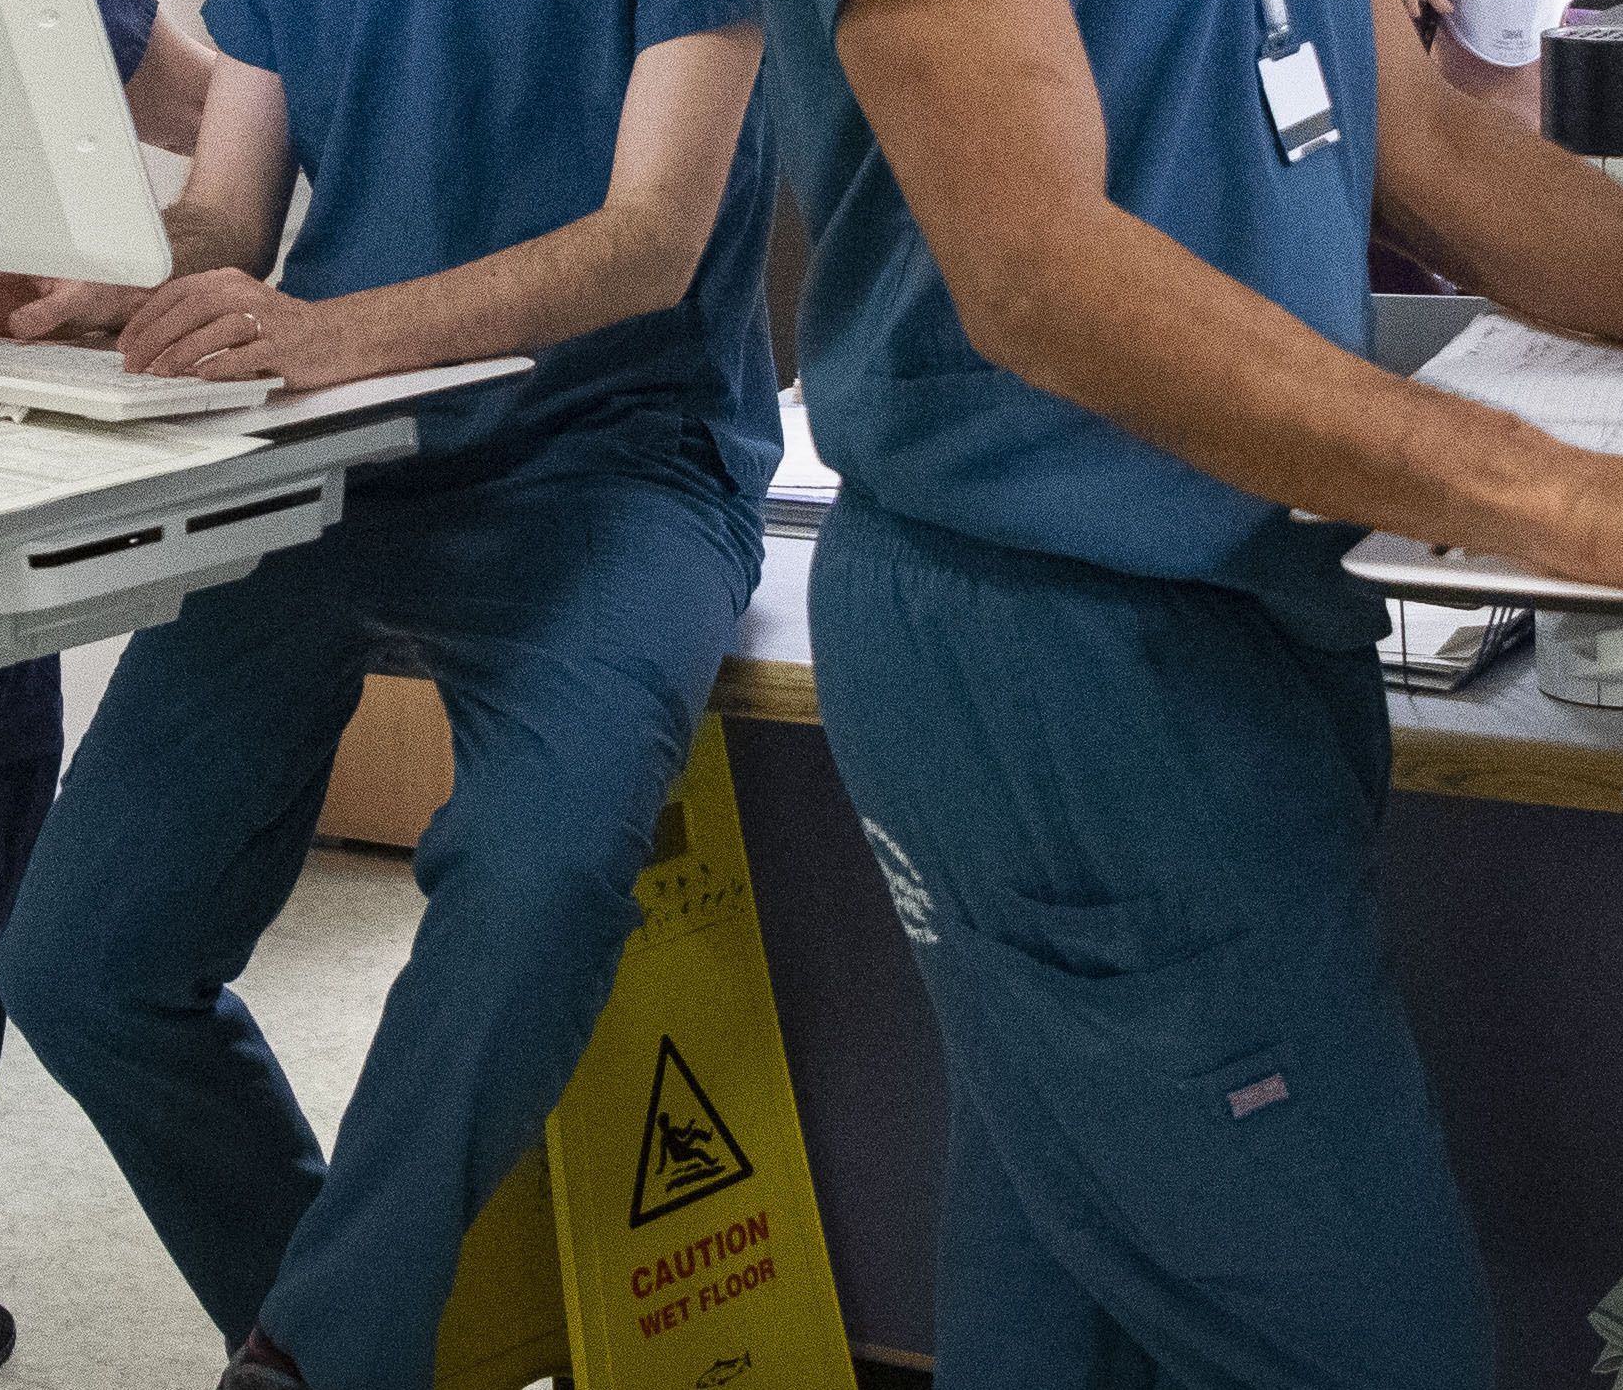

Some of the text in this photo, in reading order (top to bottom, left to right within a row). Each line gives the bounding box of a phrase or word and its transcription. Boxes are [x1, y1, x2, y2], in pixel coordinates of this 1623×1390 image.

[631, 1210, 769, 1299] CAUTION
[639, 1257, 776, 1339] WET FLOOR
